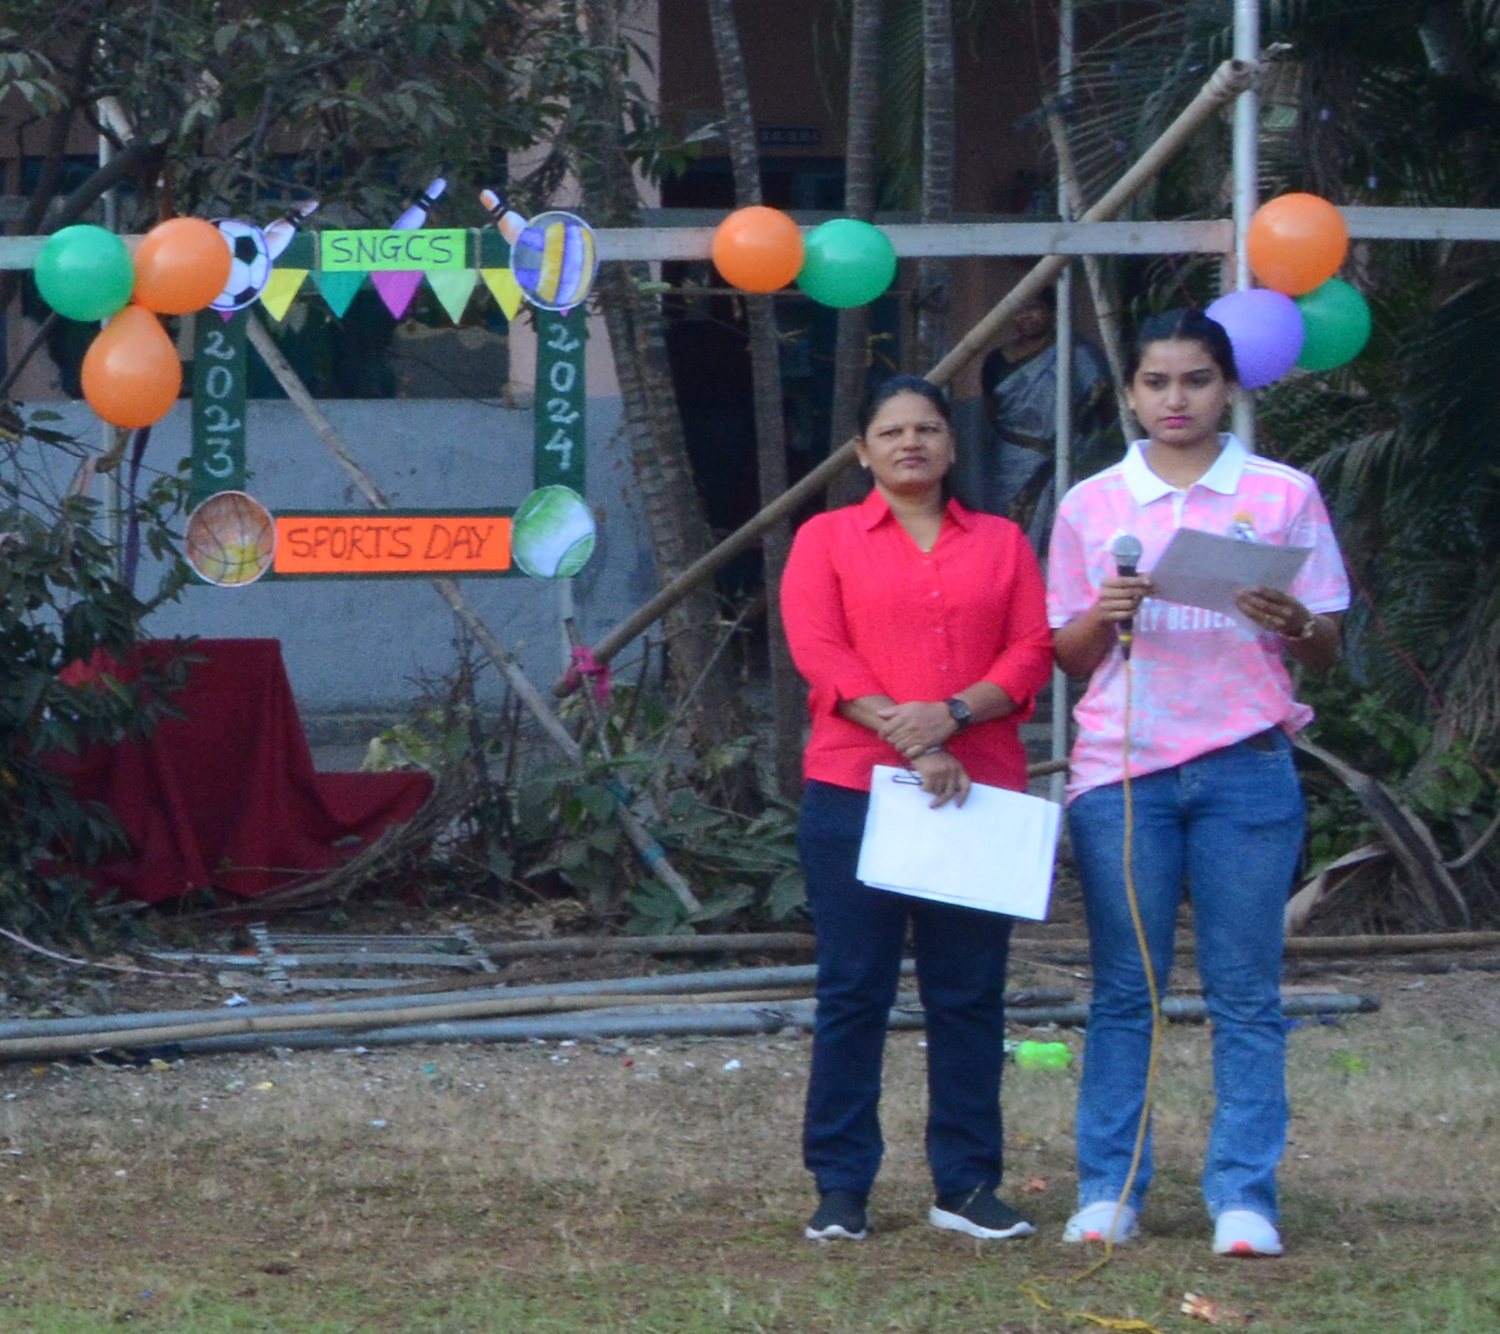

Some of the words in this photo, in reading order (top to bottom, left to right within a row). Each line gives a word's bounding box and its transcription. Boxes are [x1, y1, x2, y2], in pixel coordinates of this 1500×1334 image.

[203, 330, 242, 478] 2023
[544, 323, 580, 471] 2024
[287, 525, 413, 560] SPORTS
[424, 524, 494, 560] DAY
